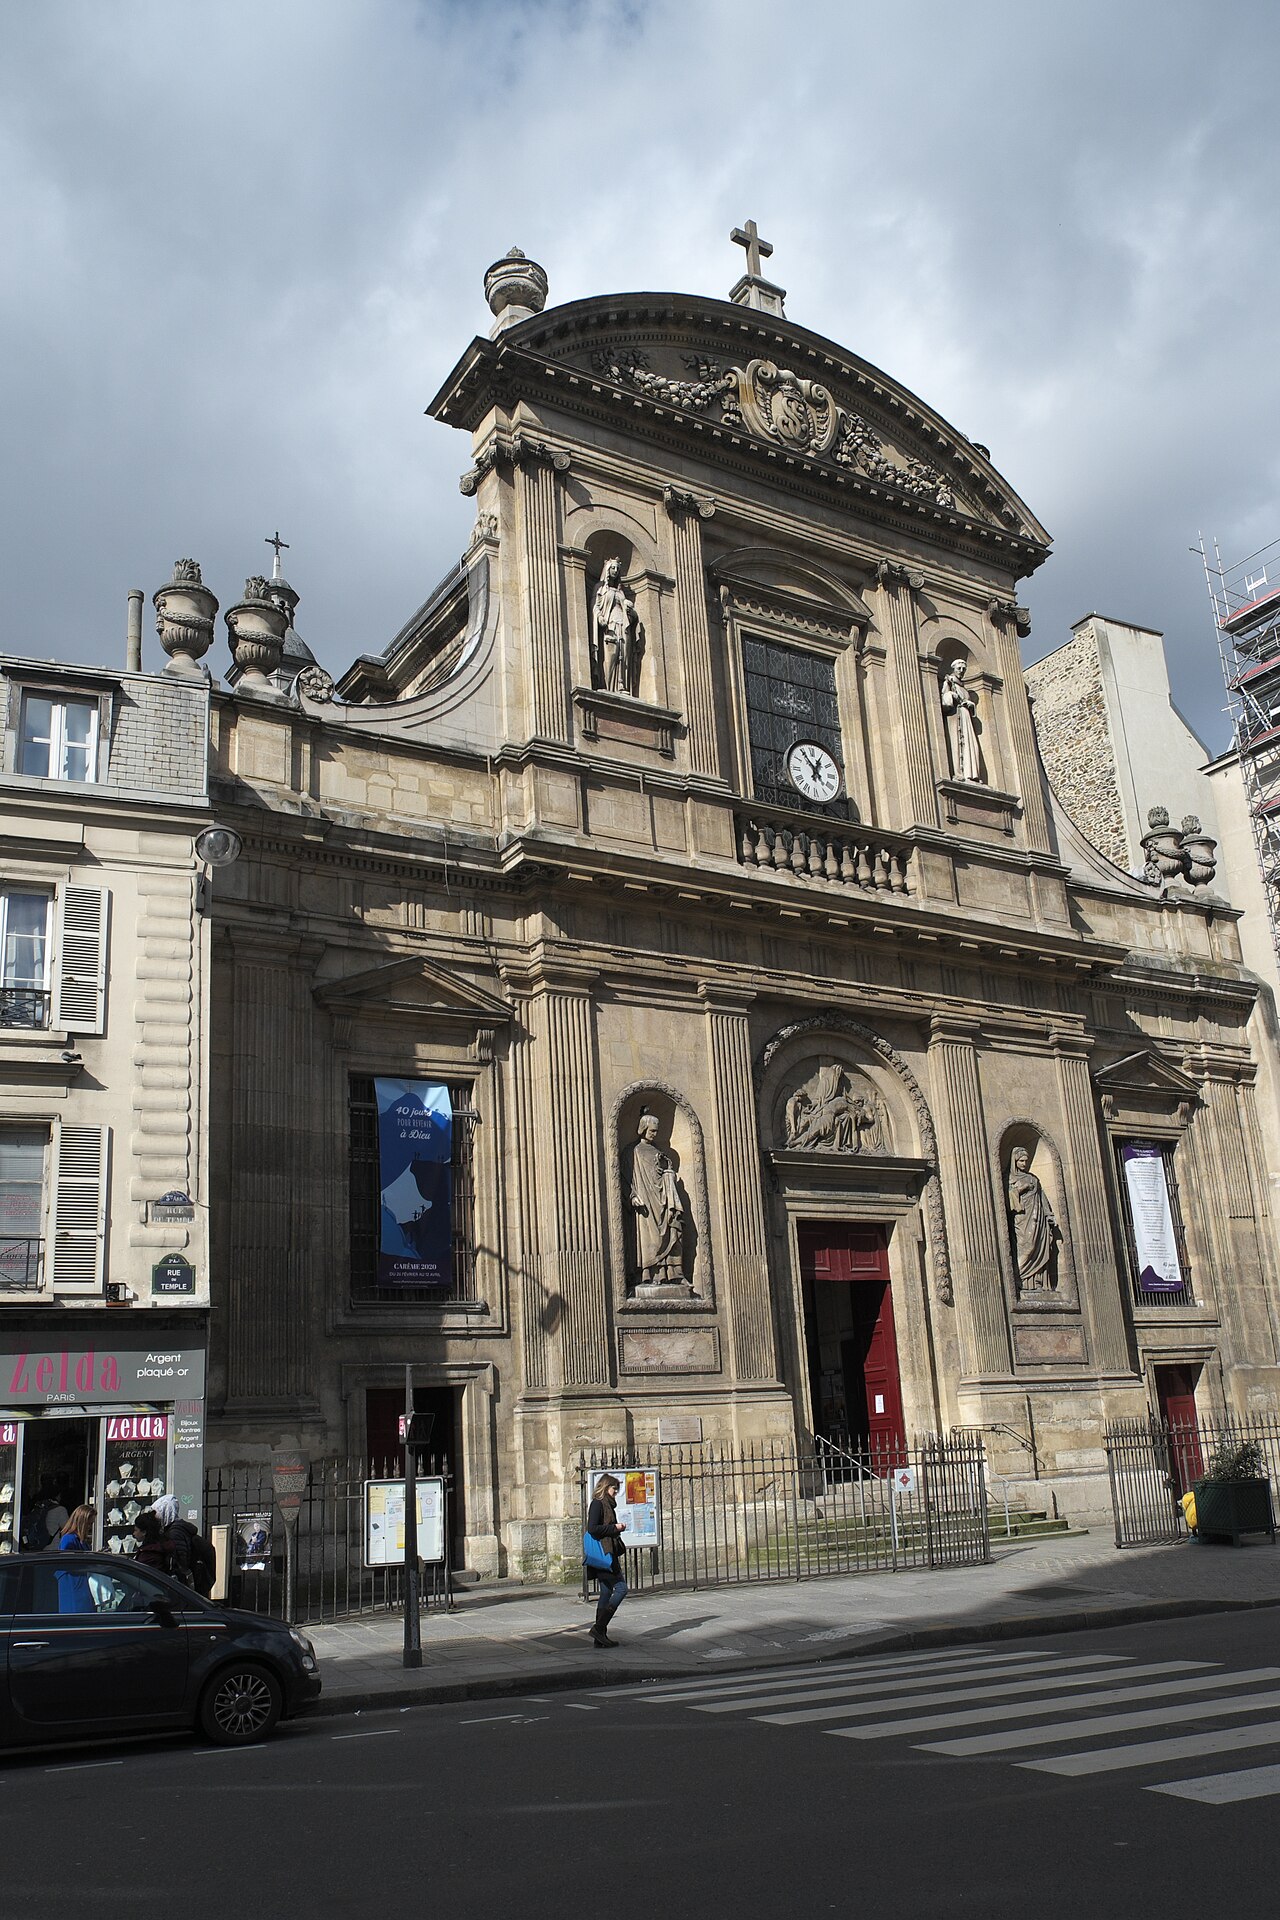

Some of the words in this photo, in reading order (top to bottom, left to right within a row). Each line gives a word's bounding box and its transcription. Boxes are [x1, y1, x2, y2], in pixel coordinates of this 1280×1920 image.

[395, 1106, 410, 1115] 40
[410, 1108, 433, 1118] jours
[400, 1129, 407, 1138] à
[408, 1130, 431, 1140] Dieu
[393, 1262, 420, 1270] CARÊME
[145, 1353, 182, 1365] Argent
[8, 1340, 122, 1393] Zelda
[46, 1394, 76, 1402] PARIS
[107, 1415, 165, 1439] Zelda
[119, 1450, 154, 1459] ARGENT
